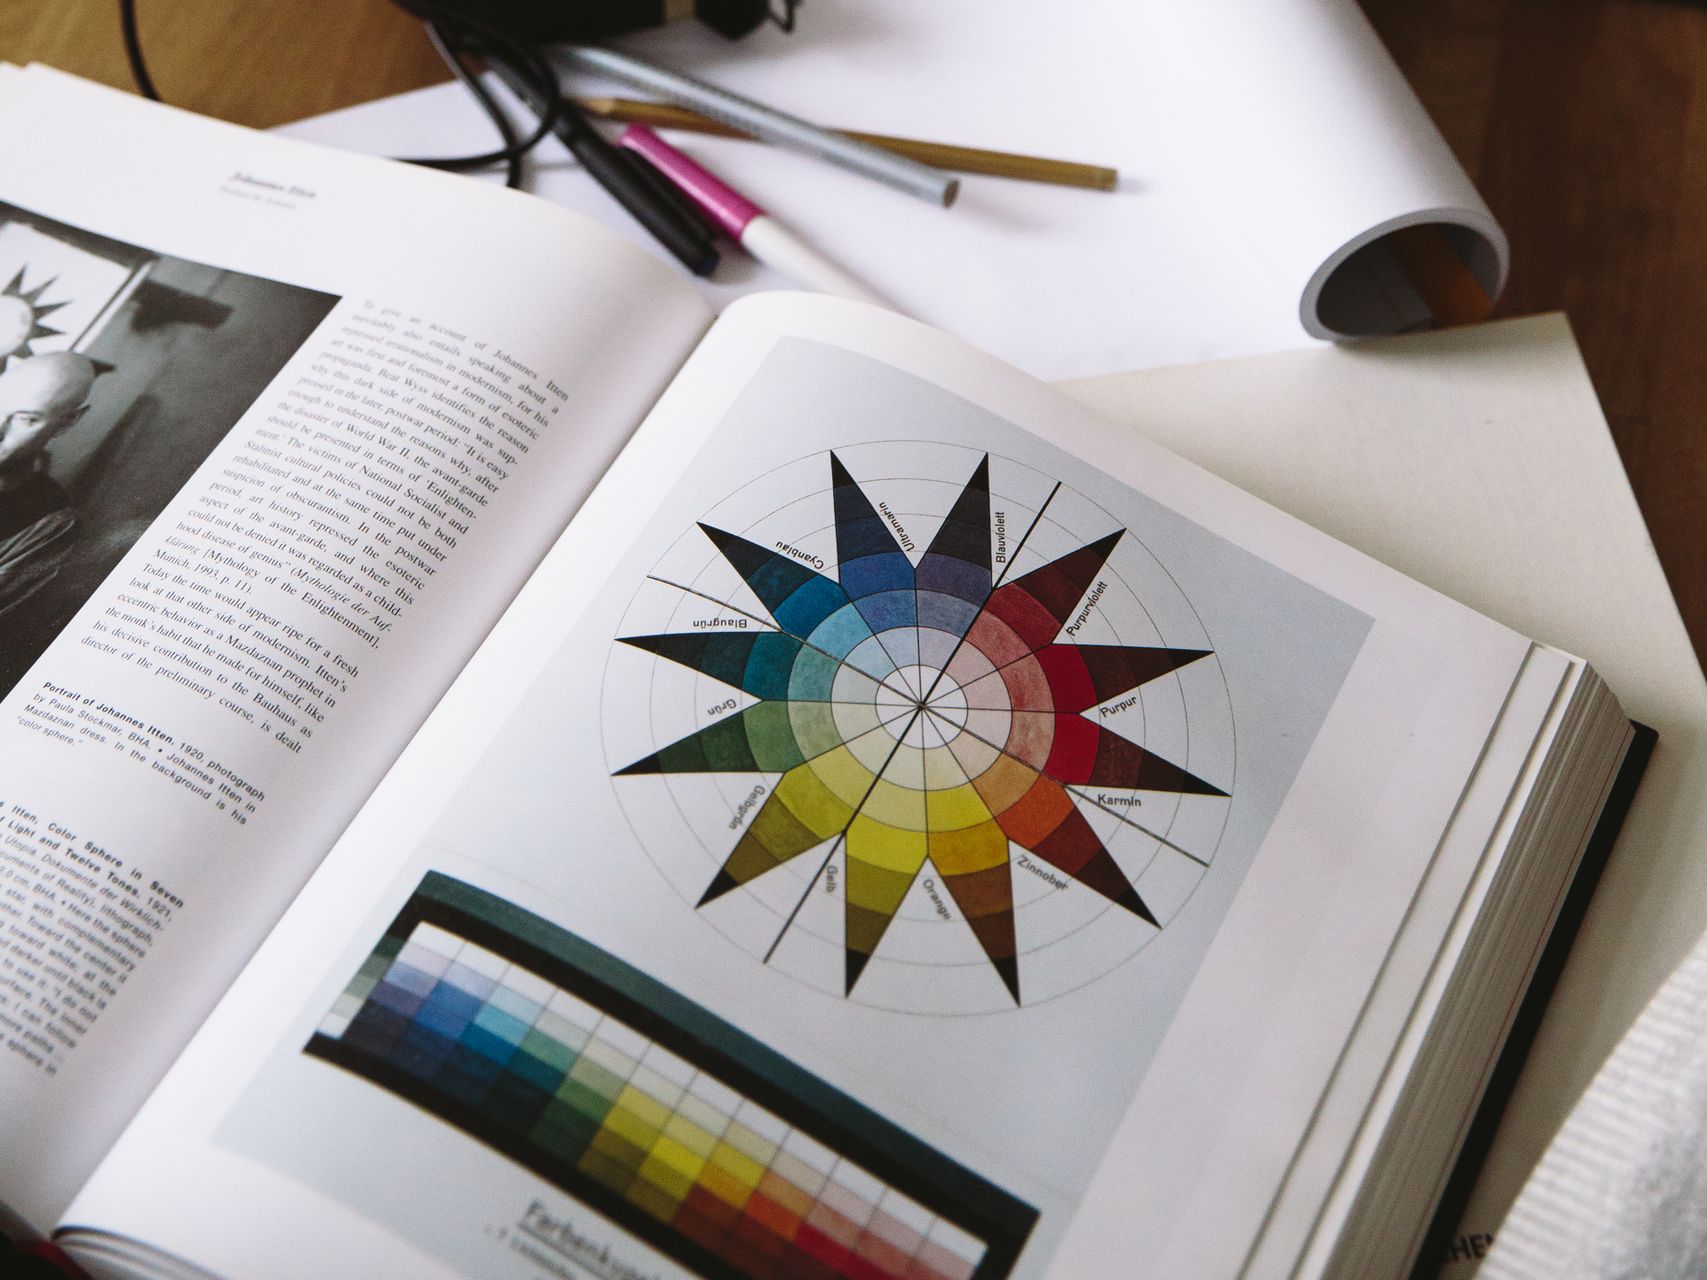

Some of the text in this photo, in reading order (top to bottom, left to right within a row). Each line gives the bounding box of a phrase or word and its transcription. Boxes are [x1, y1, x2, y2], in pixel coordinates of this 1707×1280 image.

[199, 495, 229, 513] aspect
[248, 511, 265, 523] the
[334, 551, 356, 565] and
[360, 564, 390, 587] where
[394, 587, 414, 605] this
[267, 499, 304, 521] history
[308, 519, 358, 546] repressed
[362, 545, 380, 559] the
[385, 560, 425, 590] esoteric
[879, 501, 915, 552] Ultramarin
[995, 512, 1006, 563] Blauviolett
[175, 520, 203, 536] hood
[201, 529, 237, 549] disease
[237, 544, 253, 554] of
[290, 567, 350, 604] (Mythologie
[350, 602, 370, 615] der
[369, 615, 392, 632] Auf-
[187, 510, 216, 523] could
[214, 518, 232, 529] not
[231, 521, 244, 533] be
[244, 528, 279, 547] denied
[277, 541, 287, 551] it
[288, 547, 308, 560] was
[307, 557, 354, 584] regarded
[352, 581, 365, 593] as
[373, 595, 402, 617] child-
[202, 548, 261, 578] [Mythology
[264, 575, 280, 585] of
[280, 582, 297, 595] the
[775, 540, 824, 570] Cyanblau
[129, 576, 152, 591] look
[165, 590, 185, 604] that
[186, 600, 214, 615] other
[214, 611, 236, 625] side
[238, 623, 253, 633] of
[142, 562, 171, 581] Today
[171, 574, 188, 586] the
[189, 581, 212, 595] time
[214, 591, 247, 610] would
[246, 606, 282, 627] appear
[281, 625, 304, 640] ripe
[304, 636, 323, 652] for
[332, 654, 358, 678] fresh
[692, 618, 748, 629] Blaugrün
[1066, 581, 1108, 637] Purpurviolett
[92, 619, 313, 738] his decisive contribution to the Bauhaus as
[105, 606, 121, 618] the
[156, 624, 183, 641] habit
[181, 636, 203, 650] that
[201, 643, 216, 656] he
[215, 653, 245, 671] made
[244, 666, 263, 681] for
[303, 702, 324, 722] like
[117, 594, 160, 613] eccentric
[160, 606, 203, 630] behavior
[202, 626, 216, 637] as
[225, 634, 283, 672] Mazdaznan
[281, 669, 324, 698] prophet
[324, 693, 336, 708] in
[81, 635, 119, 654] director
[121, 651, 136, 661] of
[136, 656, 153, 669] the
[154, 666, 215, 699] preliminary
[260, 719, 272, 732] is
[275, 731, 302, 753] dealt
[707, 698, 737, 716] Grün
[1100, 696, 1136, 718] Purpur
[23, 704, 75, 729] Mazdaznan
[113, 741, 125, 752] In
[129, 749, 146, 762] the
[151, 760, 212, 800] background
[215, 798, 226, 810] is
[230, 809, 247, 825] his
[32, 692, 47, 704] by
[48, 698, 74, 714] Paula
[166, 753, 215, 785] Johannes
[217, 782, 242, 803] Itten
[244, 801, 256, 813] in
[42, 681, 81, 701] Portrait
[96, 703, 144, 729] Johannes
[206, 760, 264, 801] photograph
[729, 784, 766, 831] Gelbgrün
[1098, 794, 1141, 807] Karmin
[826, 865, 838, 894] Gelb
[923, 879, 951, 921] Orange
[1017, 854, 1068, 890] Zinnober
